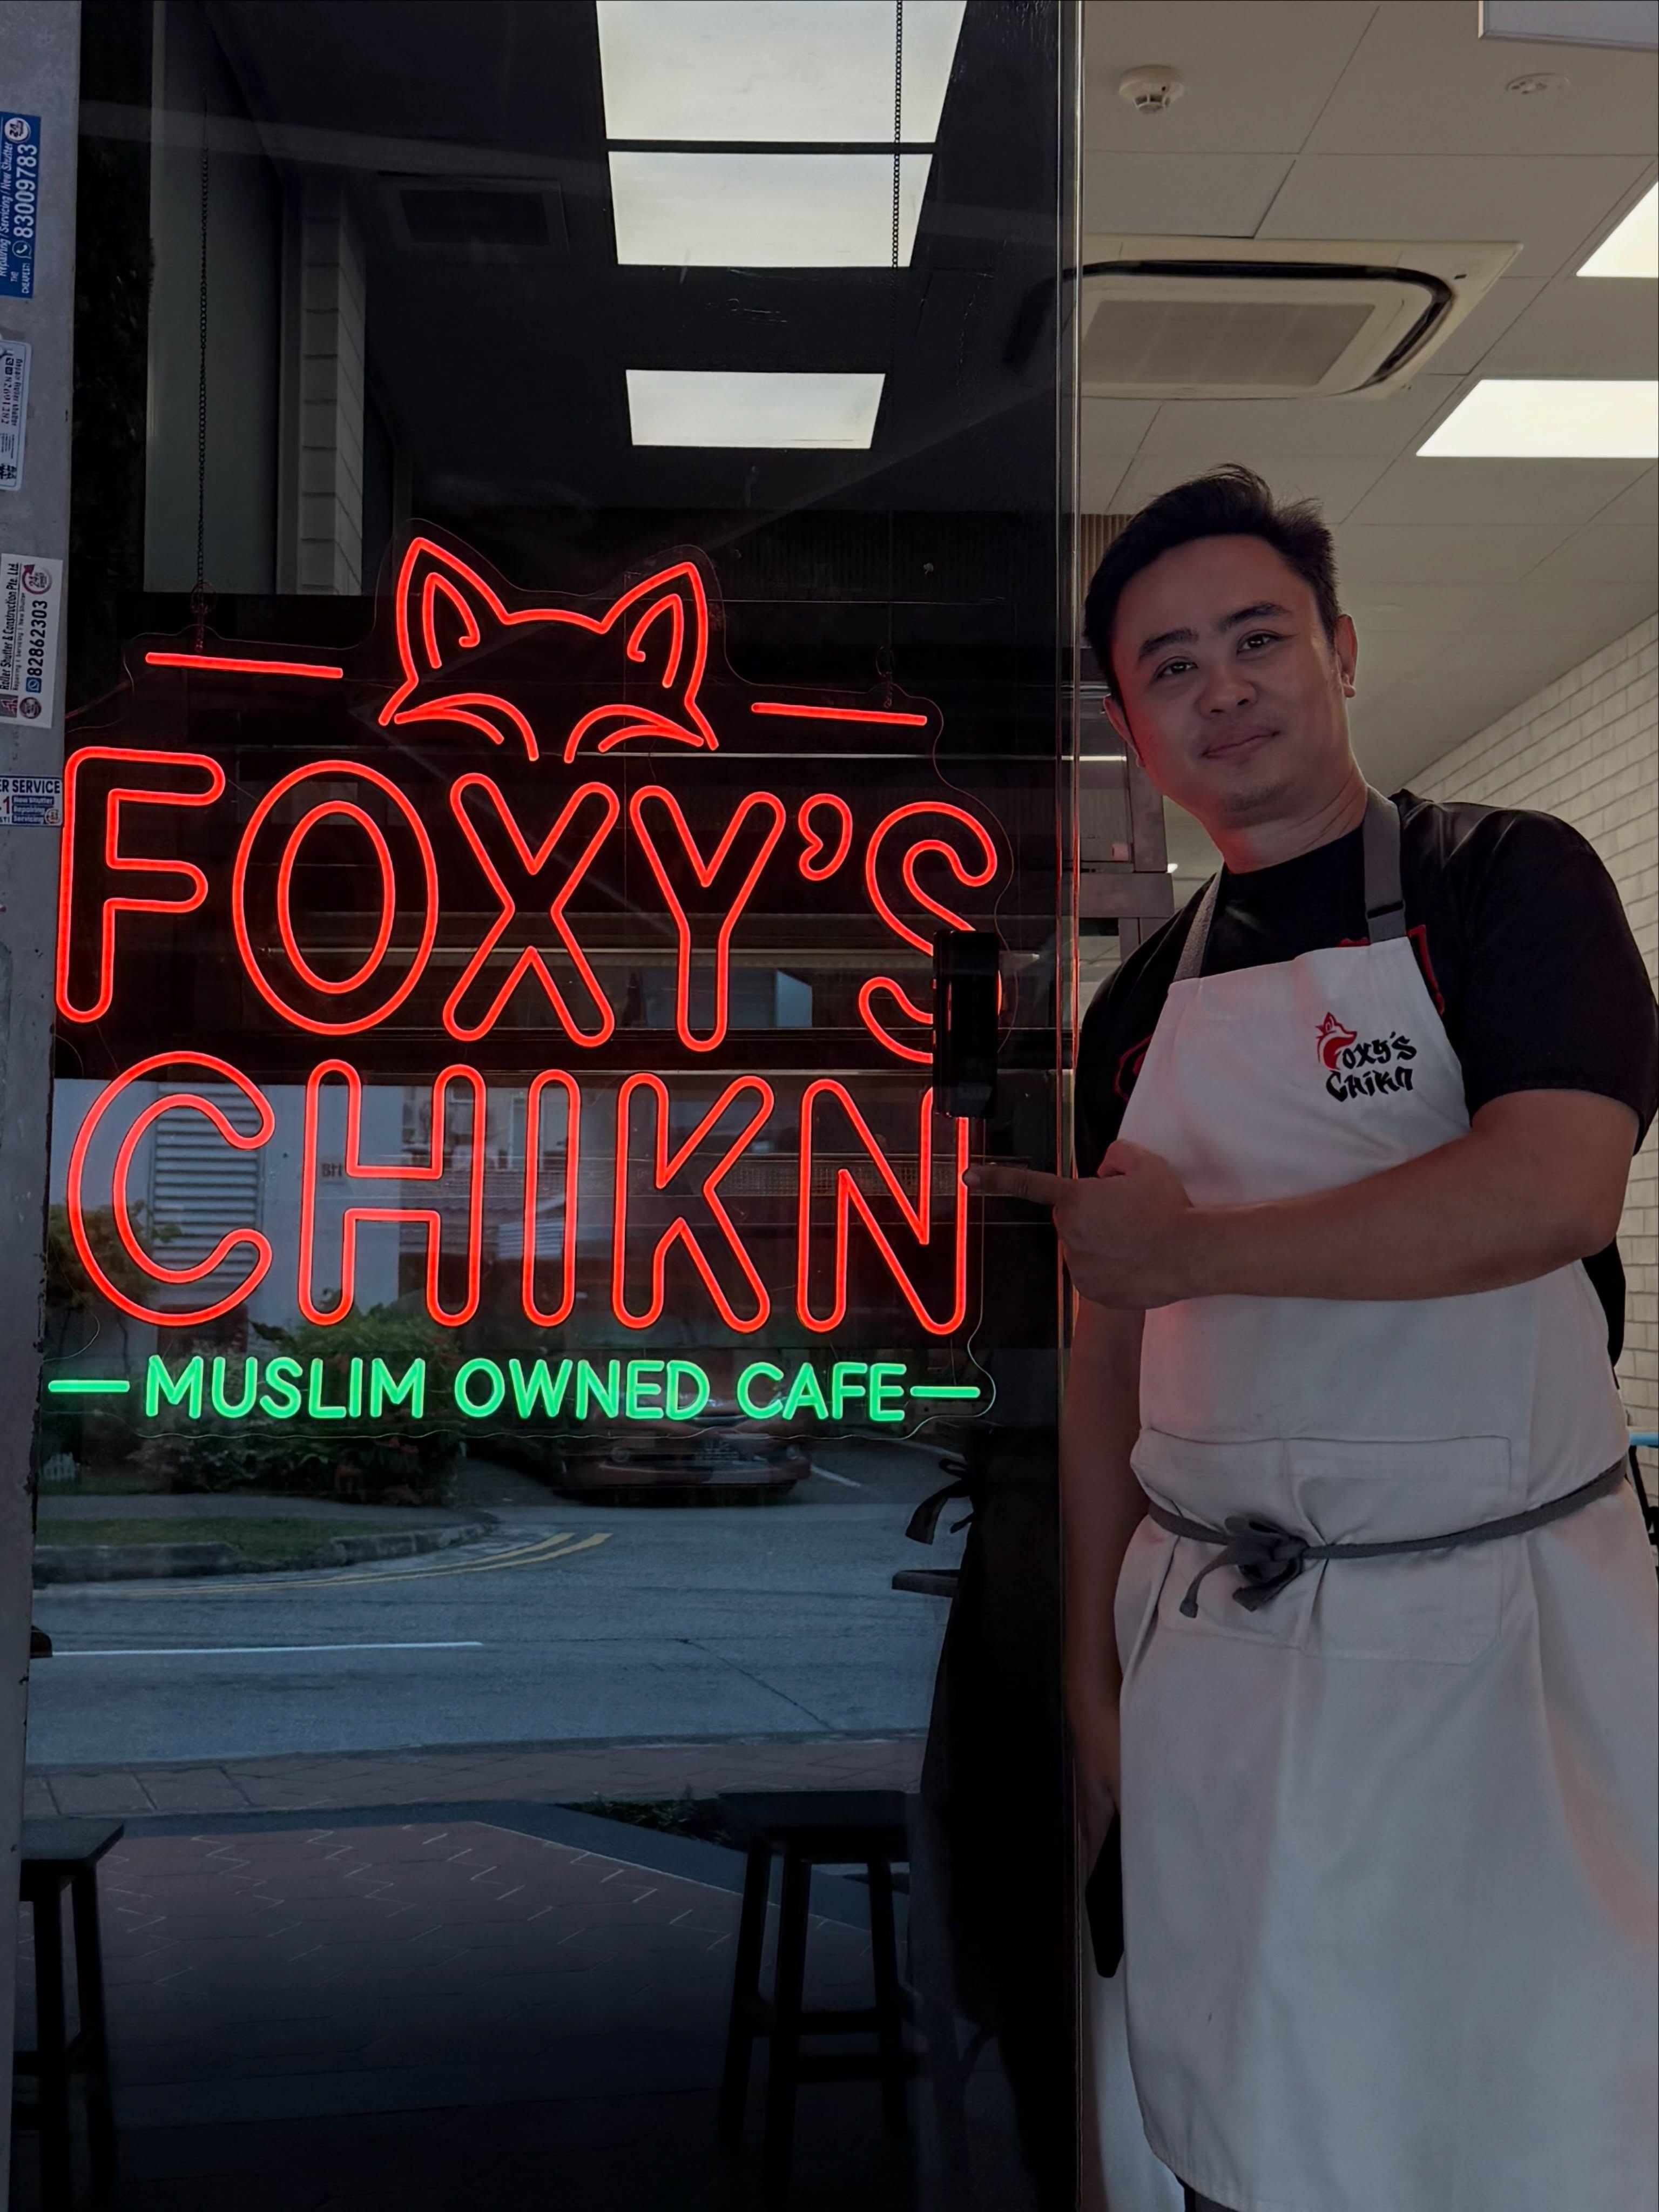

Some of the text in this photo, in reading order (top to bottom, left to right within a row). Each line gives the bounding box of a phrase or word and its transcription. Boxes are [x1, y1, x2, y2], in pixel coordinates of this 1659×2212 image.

[1, 142, 13, 171] Shutter
[0, 195, 13, 233] Servicing
[13, 144, 37, 238] 83009783
[2, 591, 17, 634] Construction
[27, 601, 48, 677] 82862303
[1, 642, 12, 668] Shutter
[12, 780, 60, 794] SERVICE
[56, 746, 1003, 1063] FOXY'S
[68, 1051, 972, 1334] CHIKN
[145, 1355, 907, 1422] MUSLIM OWNED CAFE
